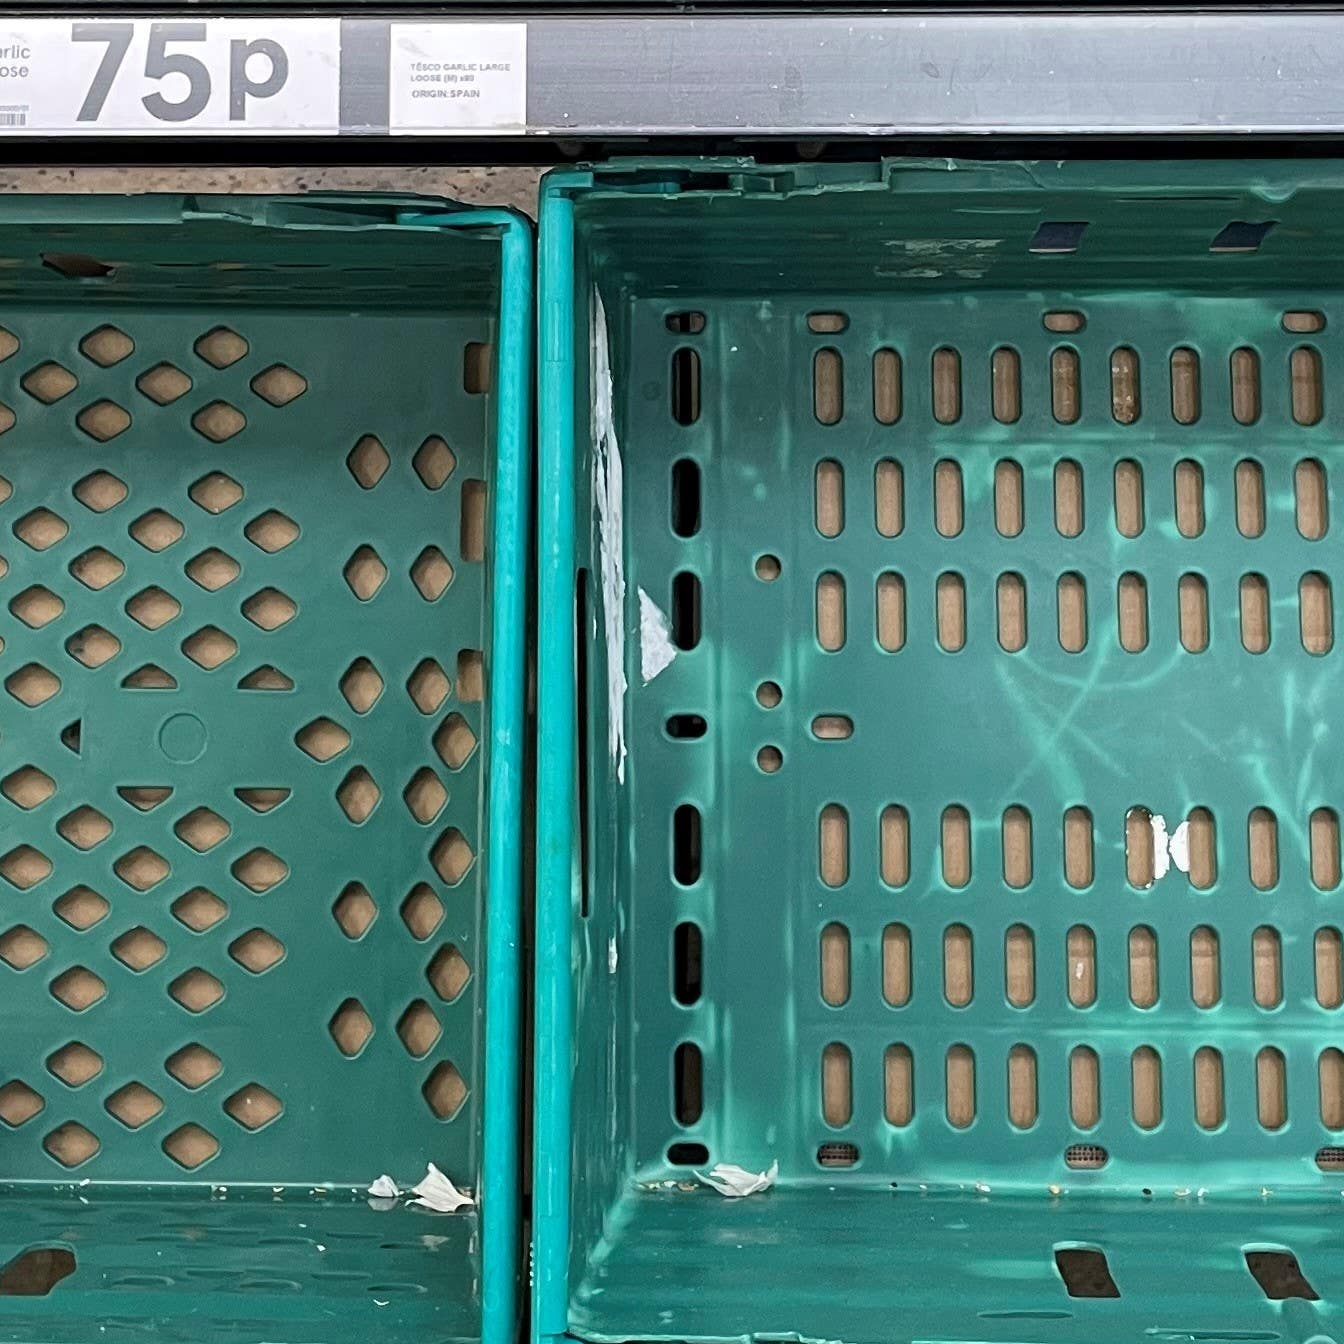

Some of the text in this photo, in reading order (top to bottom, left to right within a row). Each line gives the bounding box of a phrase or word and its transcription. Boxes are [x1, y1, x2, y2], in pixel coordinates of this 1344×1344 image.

[442, 63, 478, 72] GARLIC
[479, 63, 511, 72] LARGE
[71, 22, 290, 123] 75p
[410, 74, 442, 82] LOOSE
[449, 89, 481, 98] SPAIN
